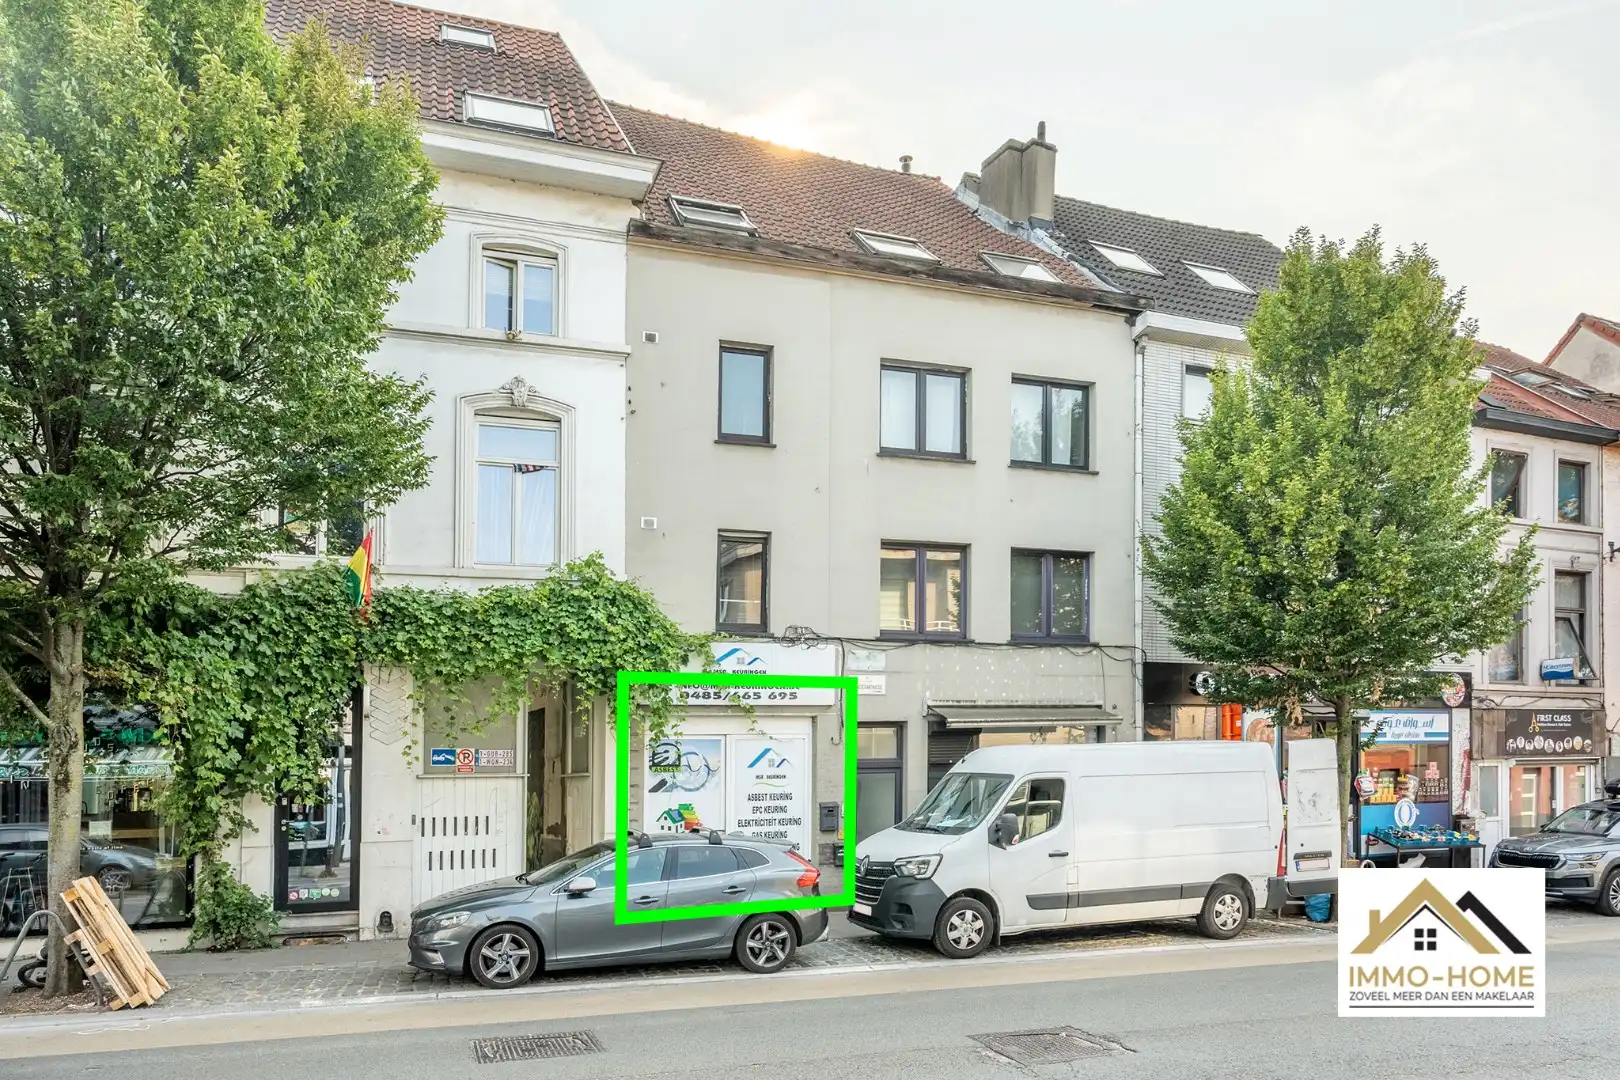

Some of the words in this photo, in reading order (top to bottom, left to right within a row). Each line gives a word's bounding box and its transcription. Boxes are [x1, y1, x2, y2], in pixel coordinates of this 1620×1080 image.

[768, 692, 798, 700] 695
[1536, 714, 1552, 722] FIRST
[1553, 714, 1572, 722] CLASS
[747, 793, 768, 802] ASBEST
[752, 806, 763, 814] EPC
